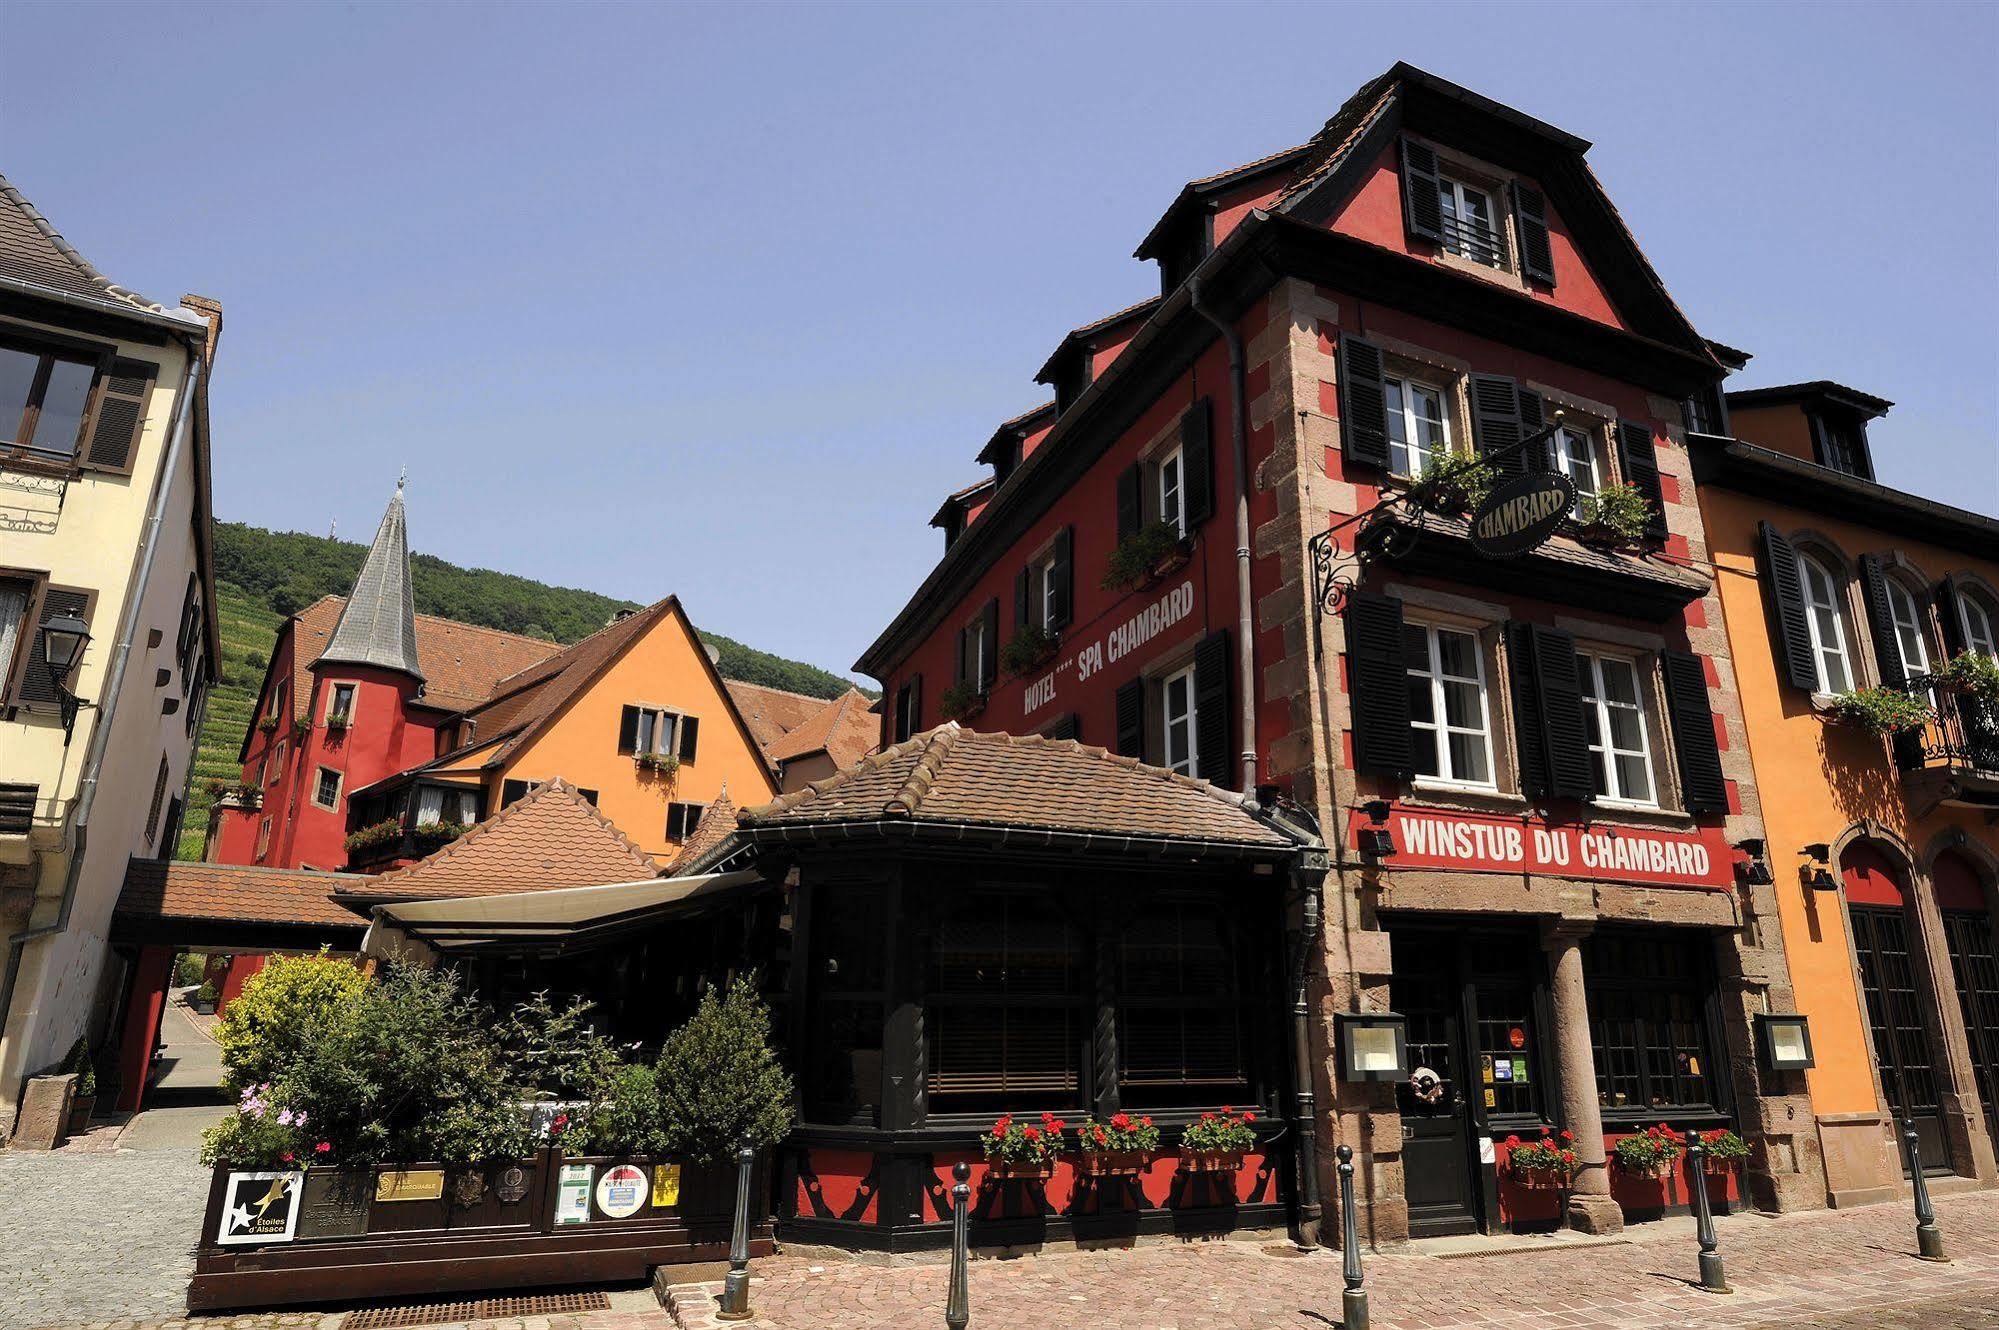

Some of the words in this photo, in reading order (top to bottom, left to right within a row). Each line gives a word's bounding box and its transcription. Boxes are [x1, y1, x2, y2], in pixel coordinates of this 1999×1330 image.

[1477, 489, 1565, 539] CHAMBARD
[1024, 672, 1057, 715] HOTEL
[1078, 641, 1103, 682] SPA
[1107, 580, 1194, 663] CHAMBARD
[1400, 817, 1525, 862] WINSTUB
[1533, 829, 1570, 866] DU
[1580, 832, 1710, 876] CHAMBARD
[249, 1226, 284, 1234] d'Alsace
[257, 1217, 285, 1226] Étoiles
